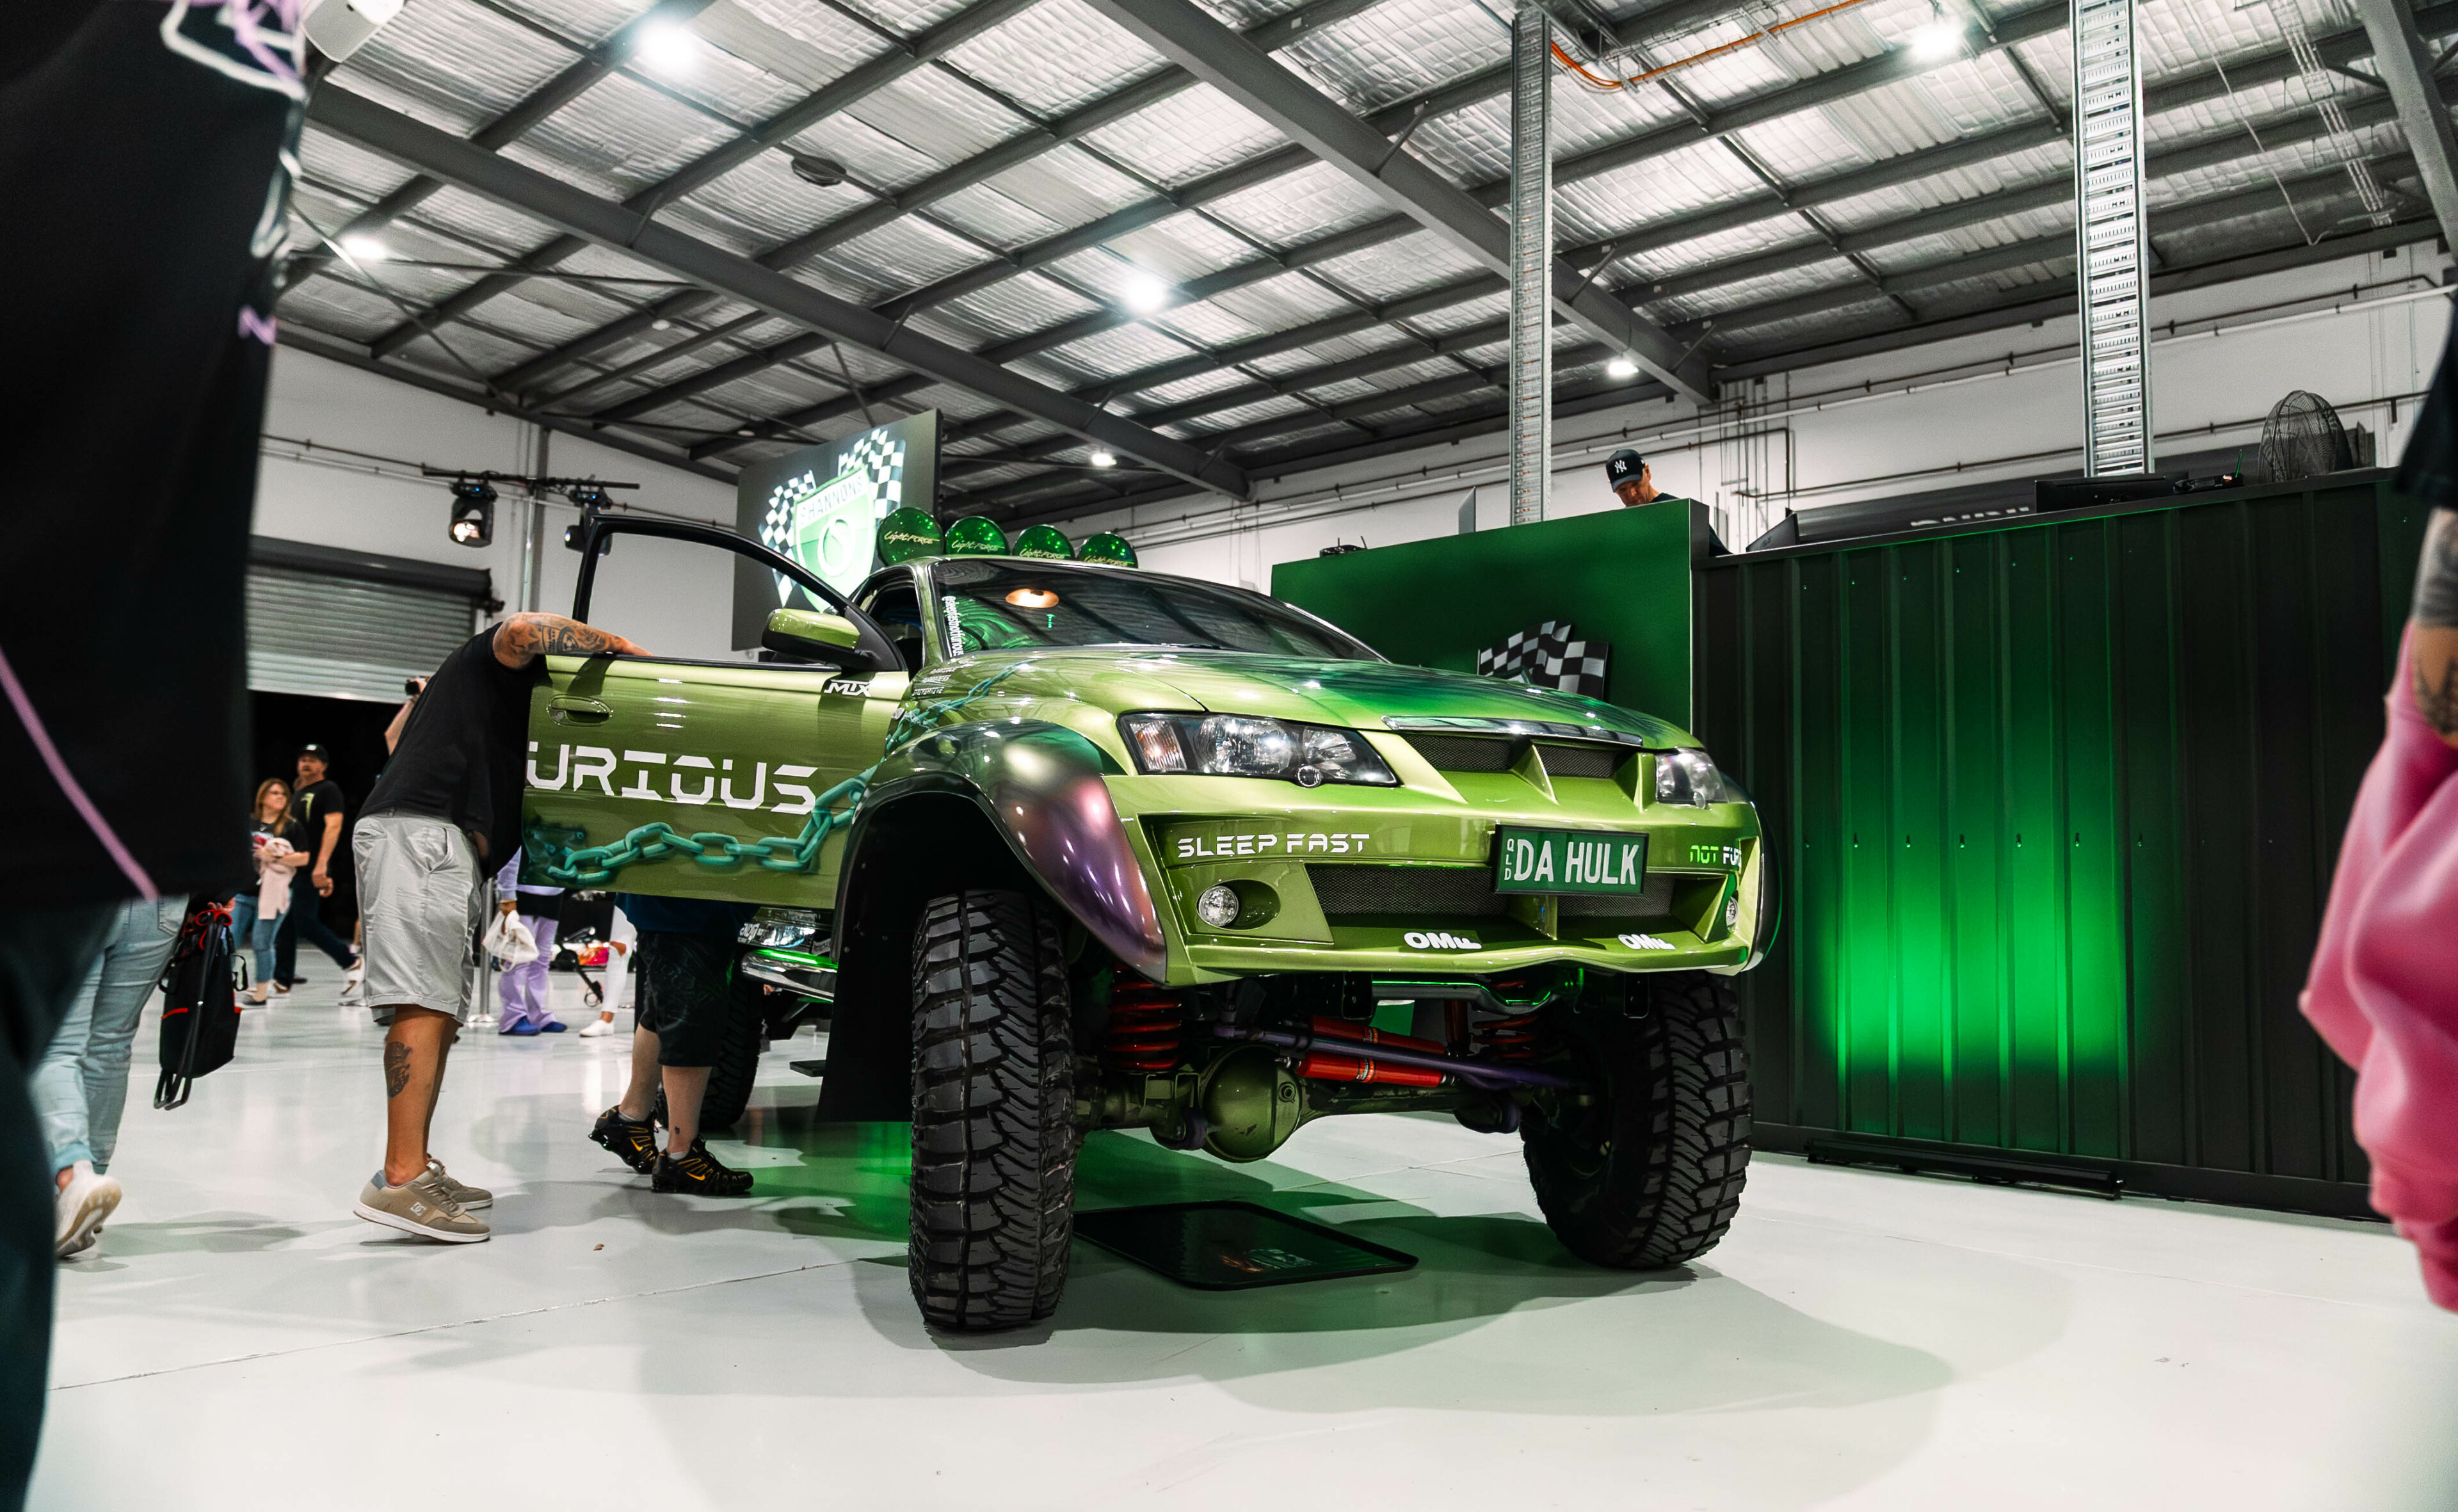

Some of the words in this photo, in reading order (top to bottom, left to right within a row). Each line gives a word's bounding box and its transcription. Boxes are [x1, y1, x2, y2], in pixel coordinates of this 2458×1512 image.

[800, 475, 864, 526] SHANNONS
[824, 679, 871, 698] MTX
[526, 741, 818, 815] URIOUS
[1178, 834, 1278, 858] SLEEP
[1287, 833, 1370, 853] FAST
[1504, 839, 1514, 880] QLD
[1514, 839, 1554, 881] DA
[1565, 841, 1639, 885] HULK
